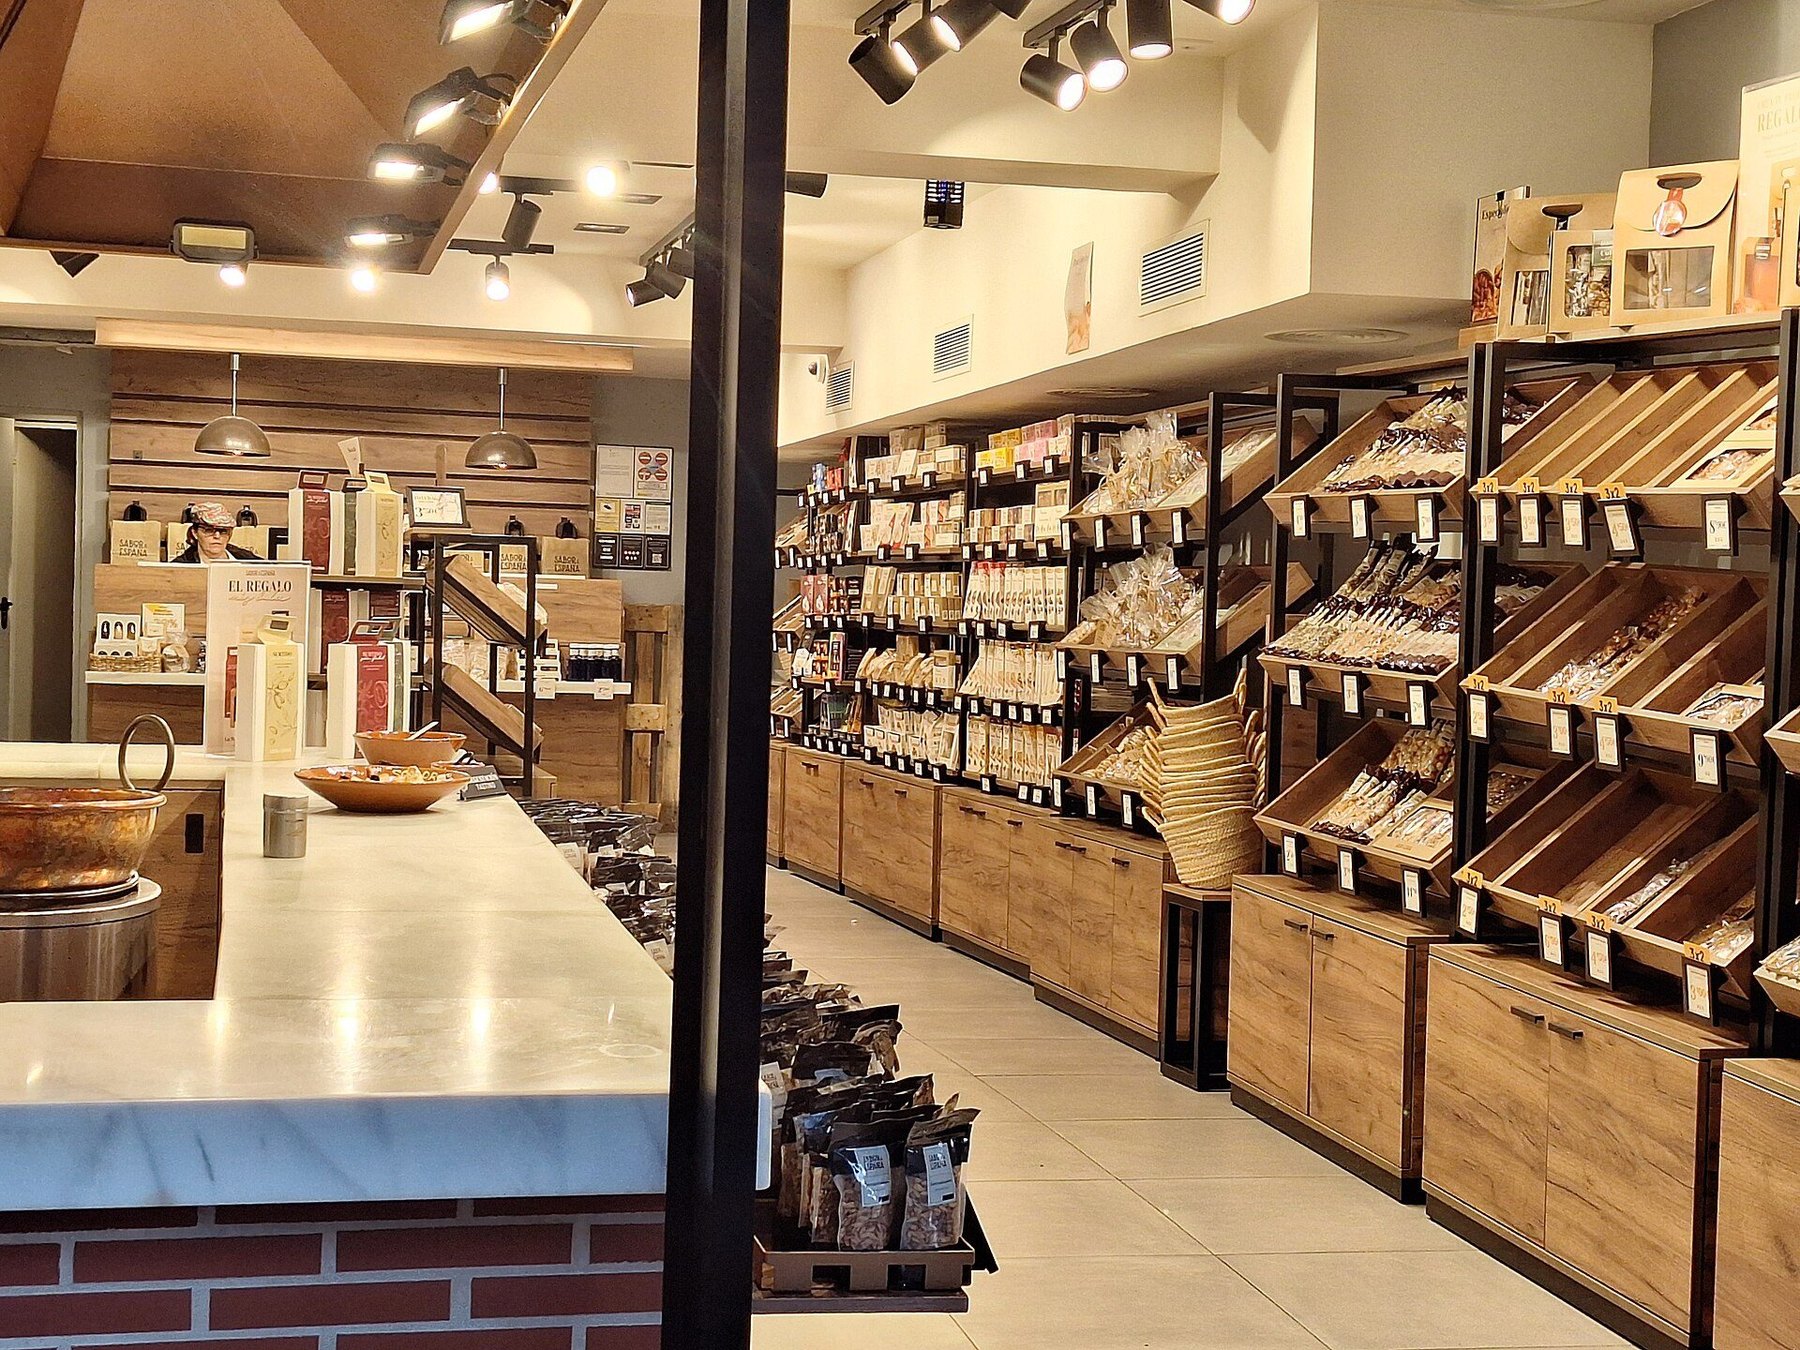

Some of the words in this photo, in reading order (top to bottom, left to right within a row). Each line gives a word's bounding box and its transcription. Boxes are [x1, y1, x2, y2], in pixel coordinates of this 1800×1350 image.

[1757, 105, 1800, 133] REGAL
[1482, 482, 1494, 493] 3x2
[1522, 482, 1535, 493] 3x2
[1565, 482, 1578, 494] 3x2
[1604, 487, 1621, 499] 3x2
[119, 538, 144, 549] SABOR
[500, 553, 523, 562] SABOR
[554, 555, 575, 564] SABOR
[228, 580, 243, 592] EL
[246, 580, 292, 592] REGALO
[1473, 678, 1485, 691] 3x2
[1552, 690, 1566, 704] 3x2
[1598, 700, 1613, 713] 3x2
[1466, 872, 1479, 887] 3x2
[1543, 900, 1557, 914] 3x2
[1591, 915, 1606, 930] 3x2
